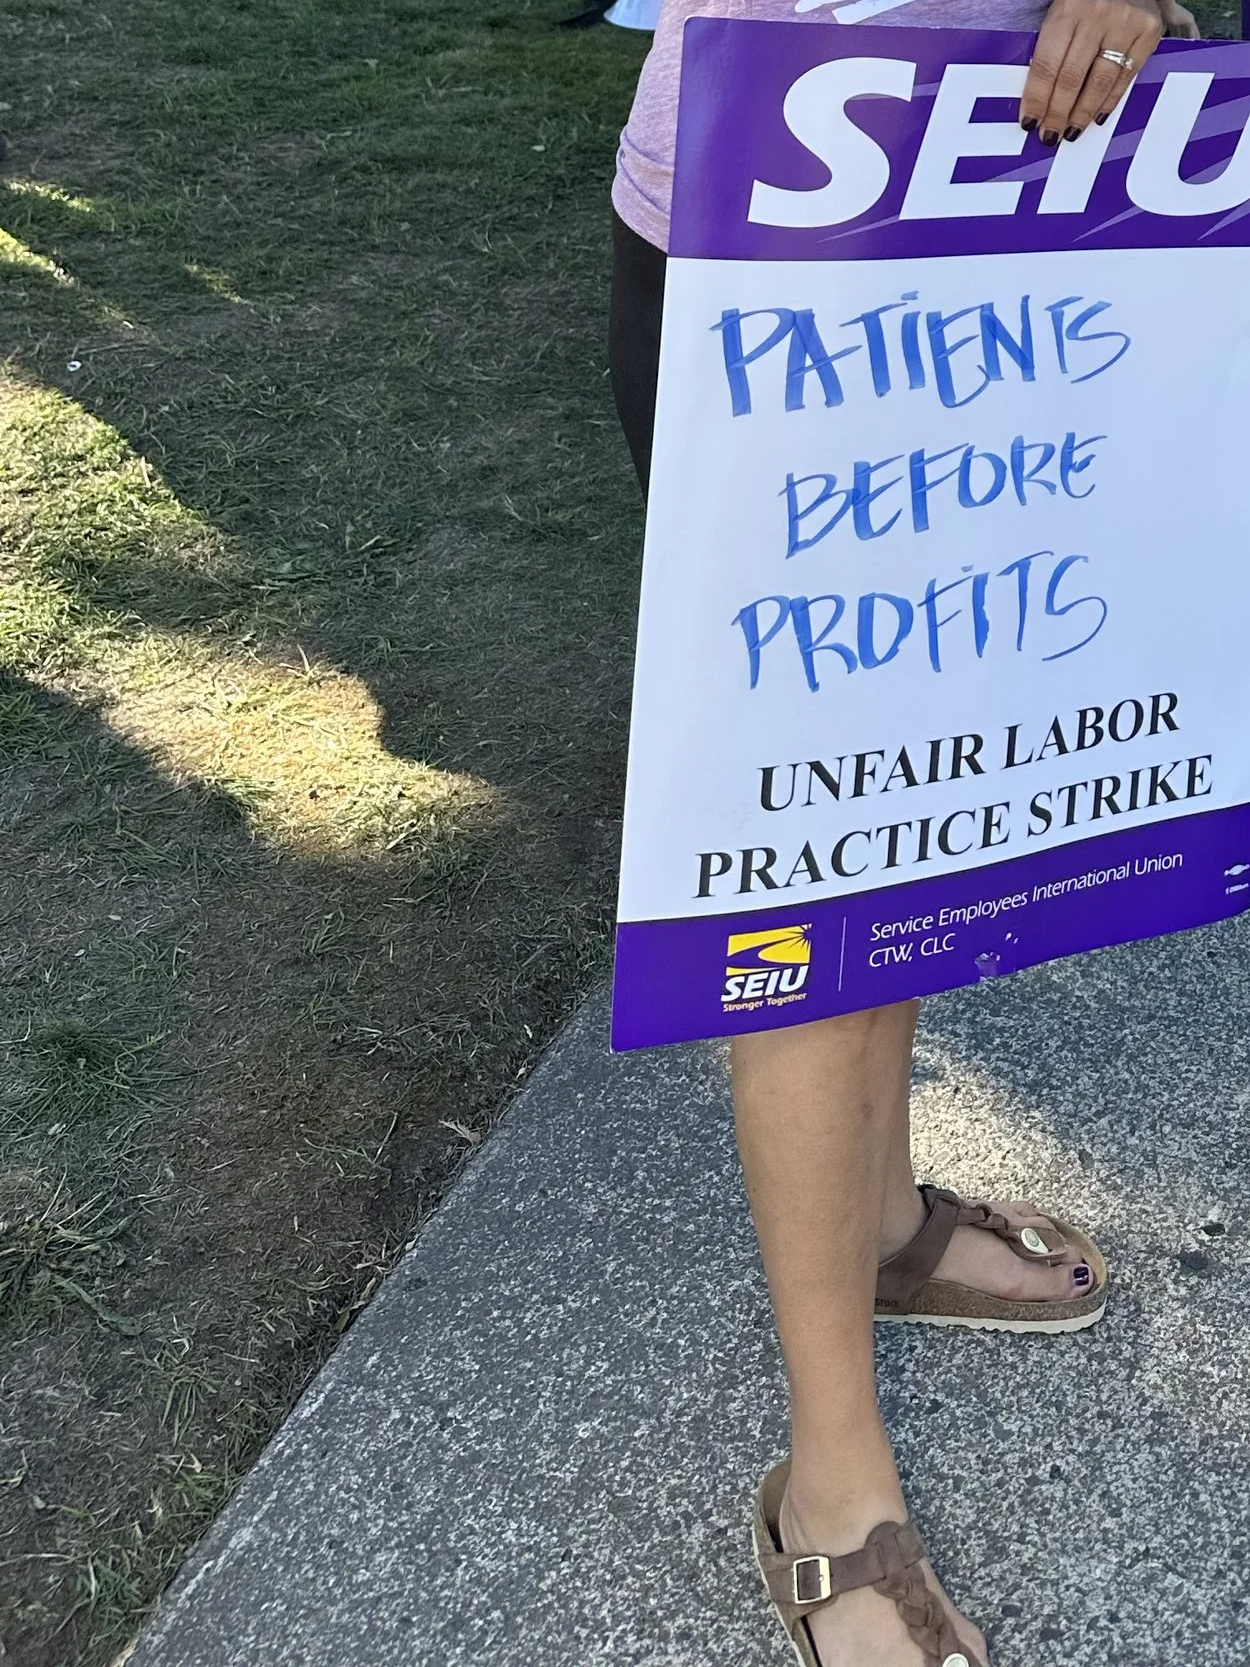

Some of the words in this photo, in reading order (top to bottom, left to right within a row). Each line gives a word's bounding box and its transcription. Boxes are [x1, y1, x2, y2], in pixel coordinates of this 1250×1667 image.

[779, 432, 1108, 560] BEFORE
[757, 733, 985, 812] UNFAIR
[1000, 692, 1181, 771] LABOR
[691, 801, 1012, 900] PRACTICE
[1026, 754, 1214, 839] STRIKE
[870, 914, 934, 942] Service
[938, 891, 1029, 926] Employees
[1032, 864, 1130, 903] International
[1134, 852, 1184, 877] Union
[720, 964, 810, 1002] SEIU
[868, 942, 914, 969] CTW,
[920, 933, 956, 956] CLC
[723, 999, 764, 1013] Stronger
[766, 993, 808, 1007] Together
